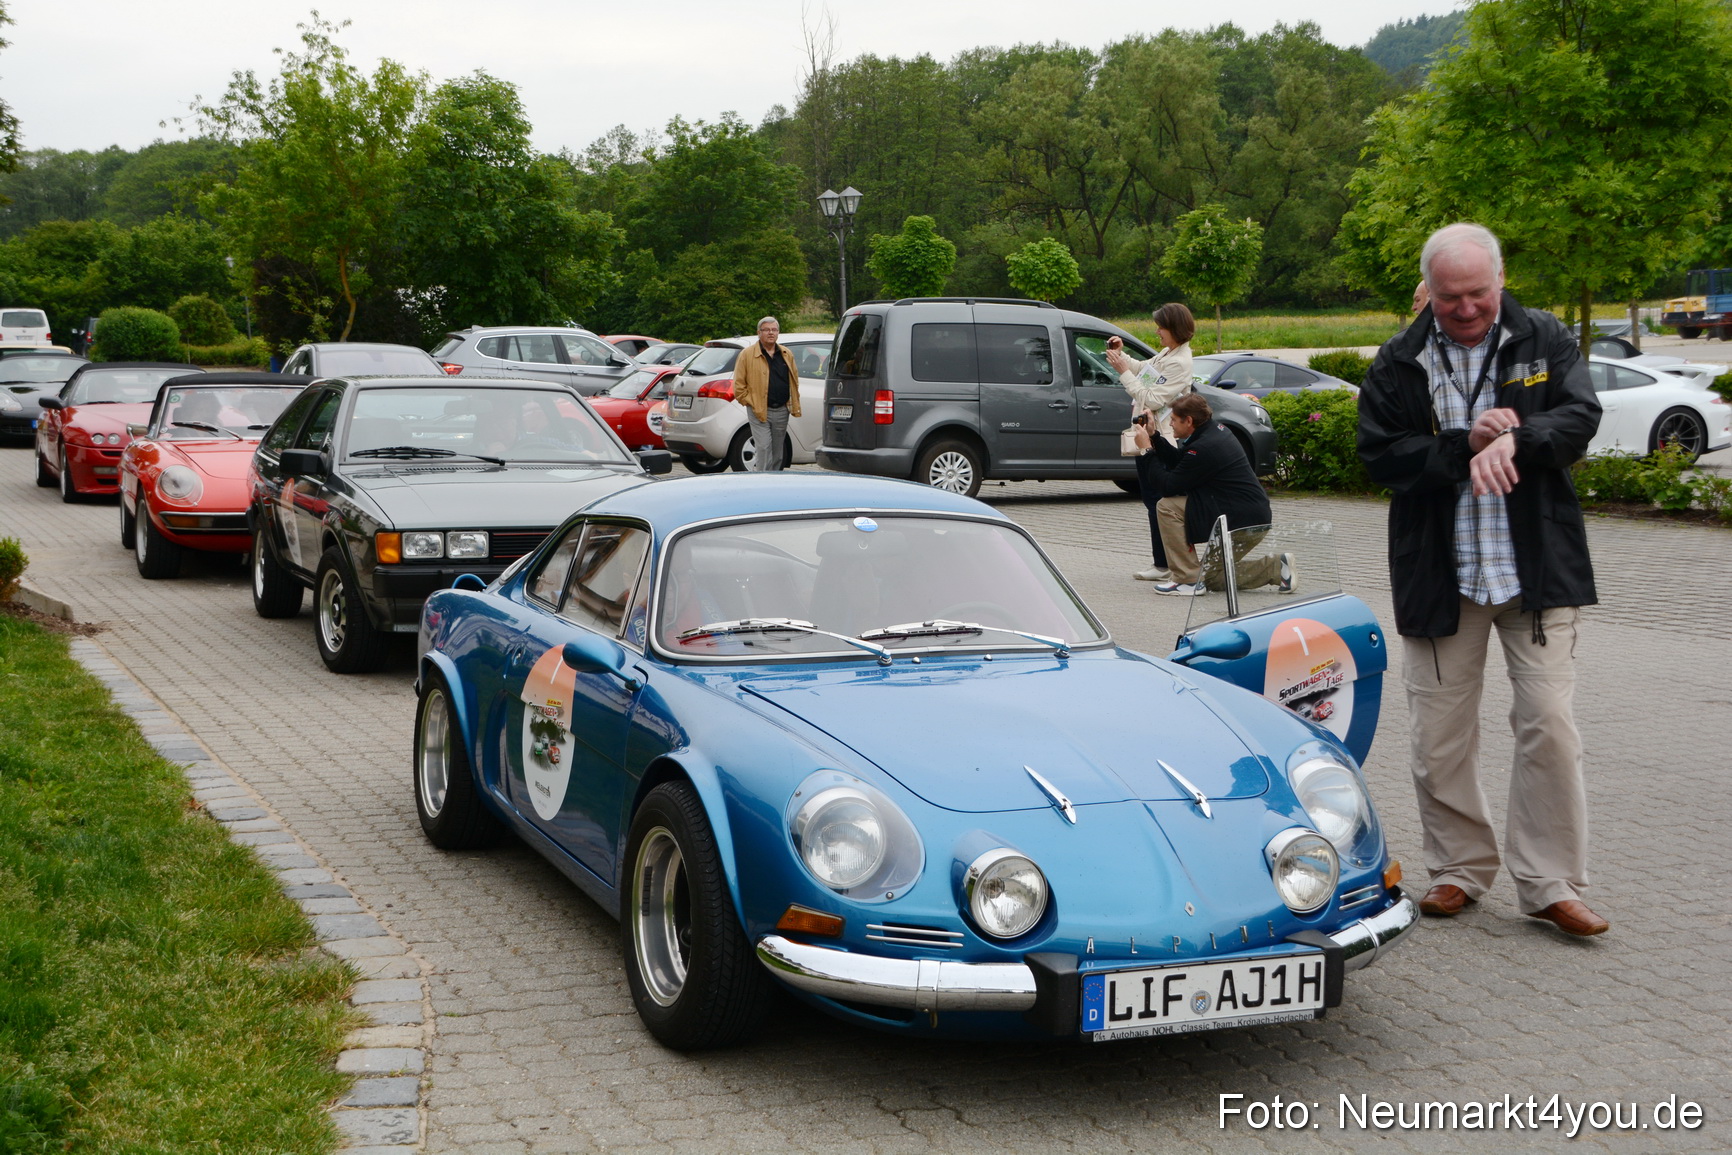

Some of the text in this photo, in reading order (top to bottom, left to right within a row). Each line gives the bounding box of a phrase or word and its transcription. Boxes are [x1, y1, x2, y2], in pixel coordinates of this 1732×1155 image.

[1292, 626, 1310, 656] 1
[1086, 919, 1276, 955] ALPINE
[1108, 961, 1322, 1022] LIF AJ1H
[1089, 1008, 1099, 1022] D
[1109, 1029, 1150, 1040] Autohaus
[1180, 1021, 1211, 1032] Classic
